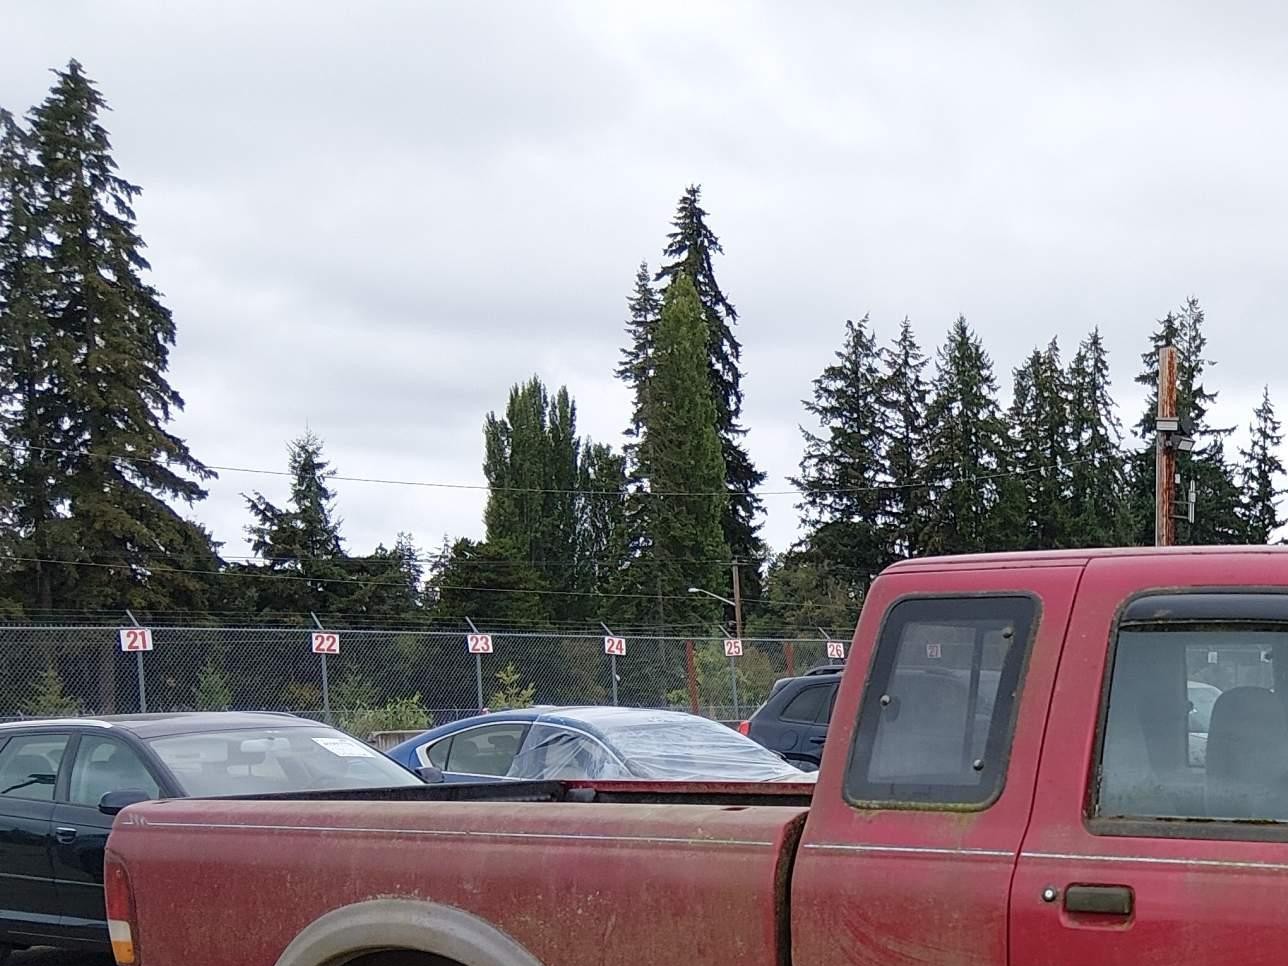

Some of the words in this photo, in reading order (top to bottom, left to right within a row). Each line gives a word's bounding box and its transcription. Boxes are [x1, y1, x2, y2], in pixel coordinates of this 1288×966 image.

[126, 630, 147, 650] 21
[314, 634, 337, 652] 22
[469, 635, 490, 651] 23
[606, 638, 624, 654] 24
[726, 641, 740, 655] 25
[829, 643, 842, 657] 26
